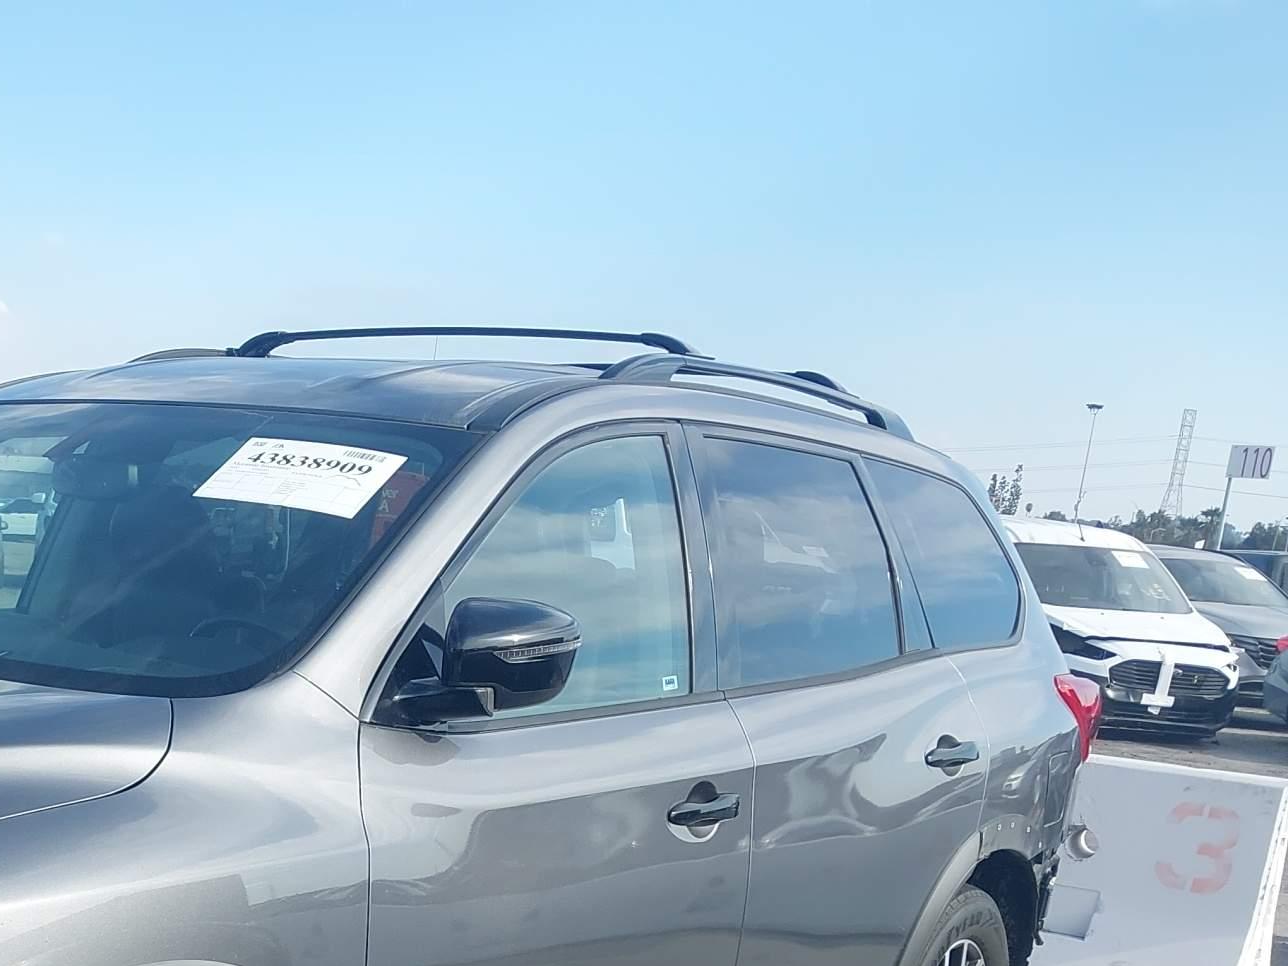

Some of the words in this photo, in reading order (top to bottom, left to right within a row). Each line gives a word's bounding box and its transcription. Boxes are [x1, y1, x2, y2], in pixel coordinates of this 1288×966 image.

[247, 451, 373, 476] 43838909
[1240, 447, 1273, 479] 110
[1154, 801, 1241, 894] 3
